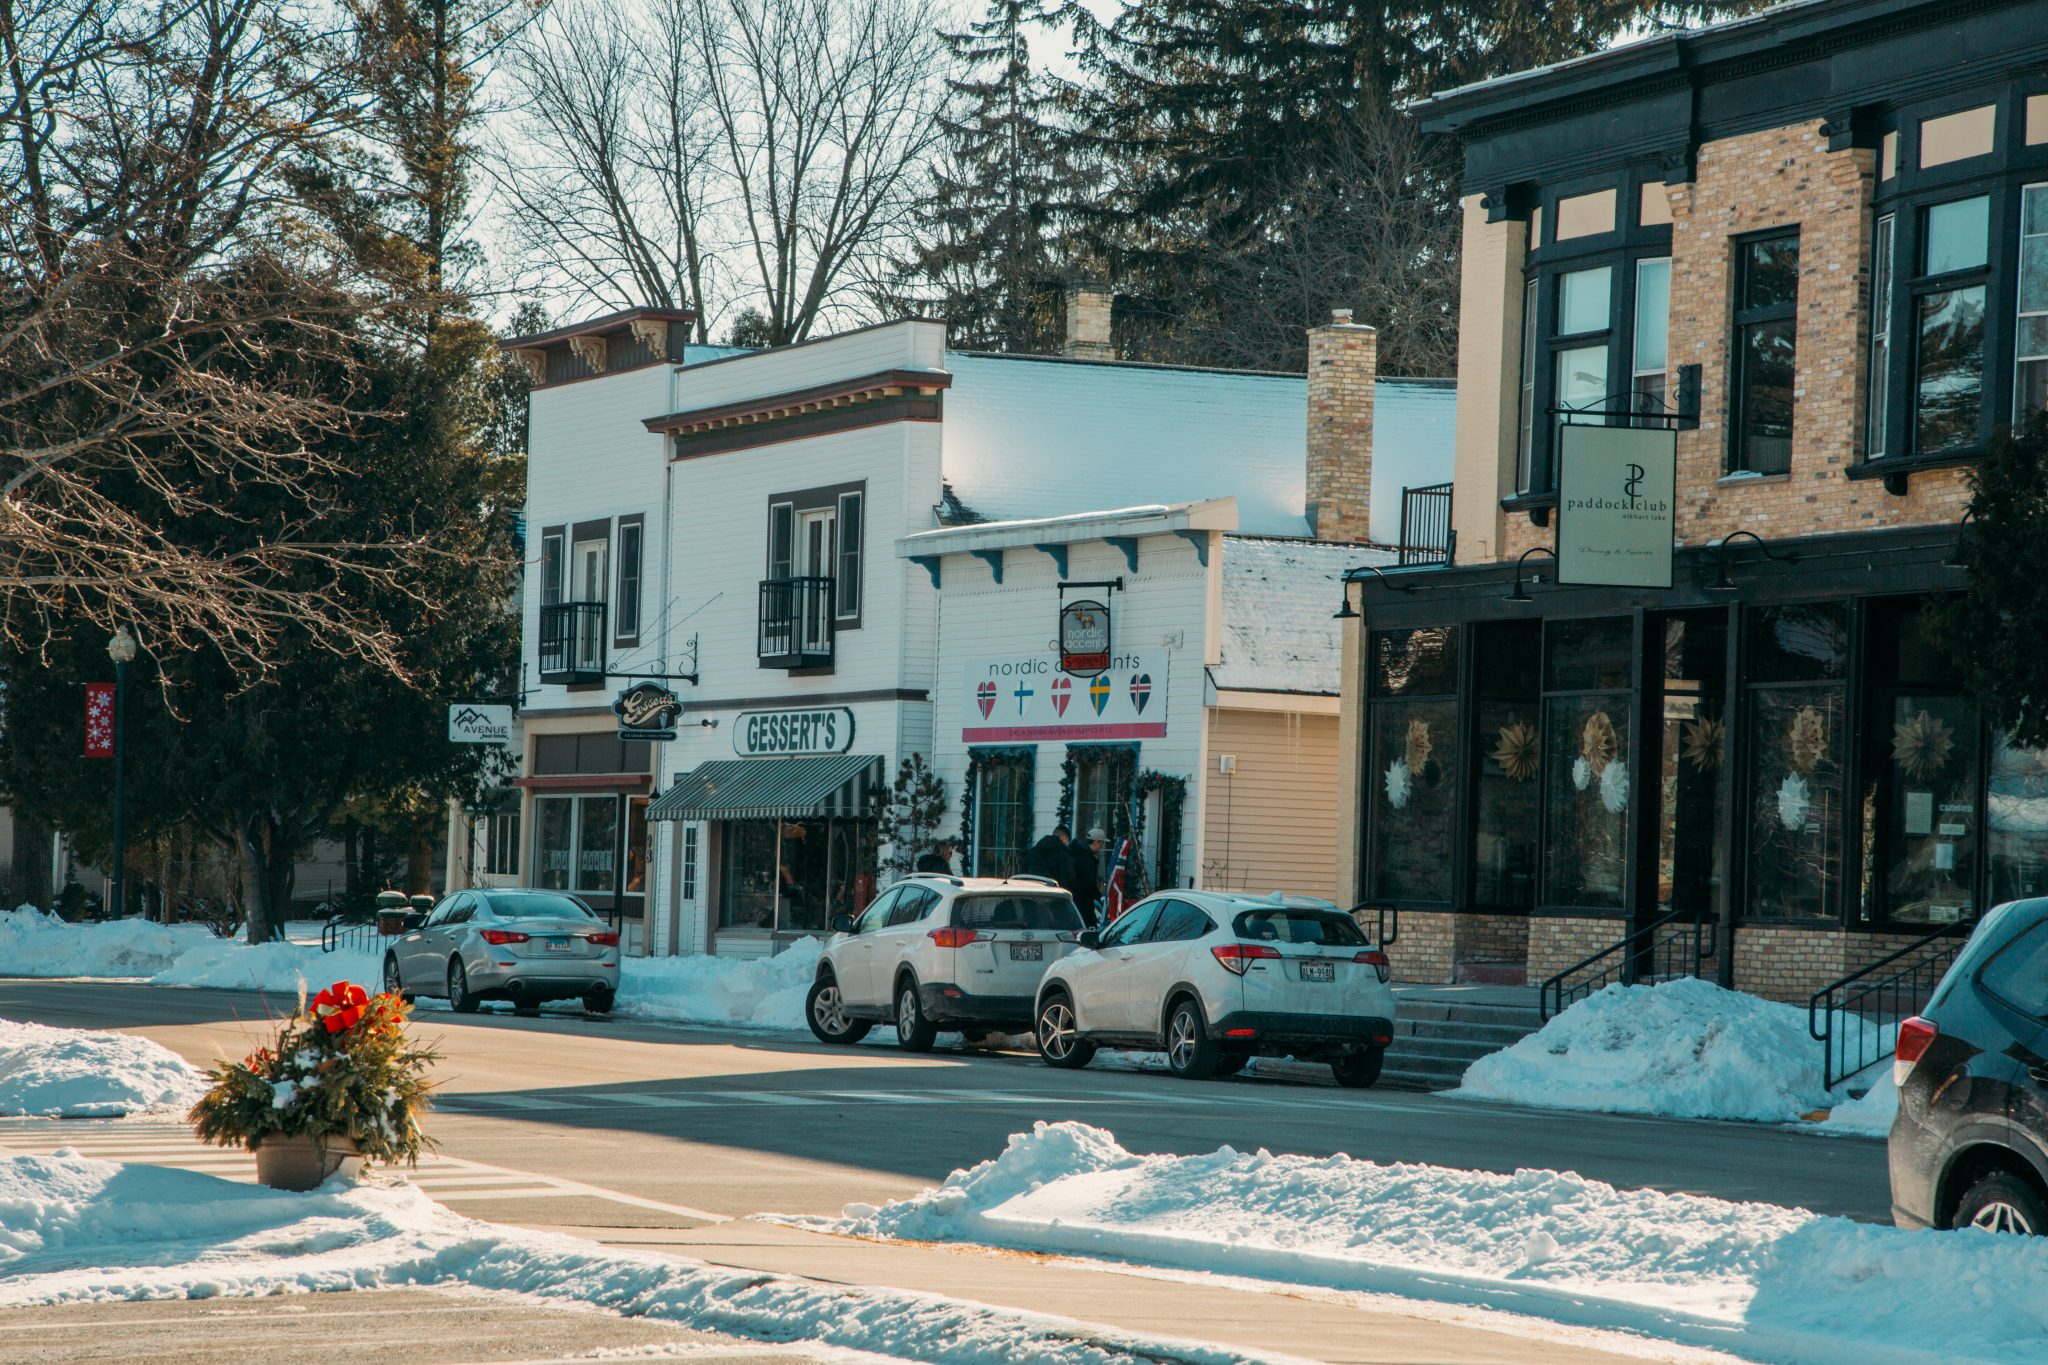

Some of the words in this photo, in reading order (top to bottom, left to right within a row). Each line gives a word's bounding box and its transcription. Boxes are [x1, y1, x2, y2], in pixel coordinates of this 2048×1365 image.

[1568, 498, 1629, 511] paddock
[1635, 500, 1667, 512] club
[1067, 627, 1104, 640] nordic
[1064, 639, 1107, 649] accents
[989, 659, 1048, 676] nordic
[623, 691, 677, 724] Gessert's
[464, 725, 508, 734] AVENUE
[747, 712, 836, 752] GESSERT'S
[1939, 804, 1974, 813] CLOSED
